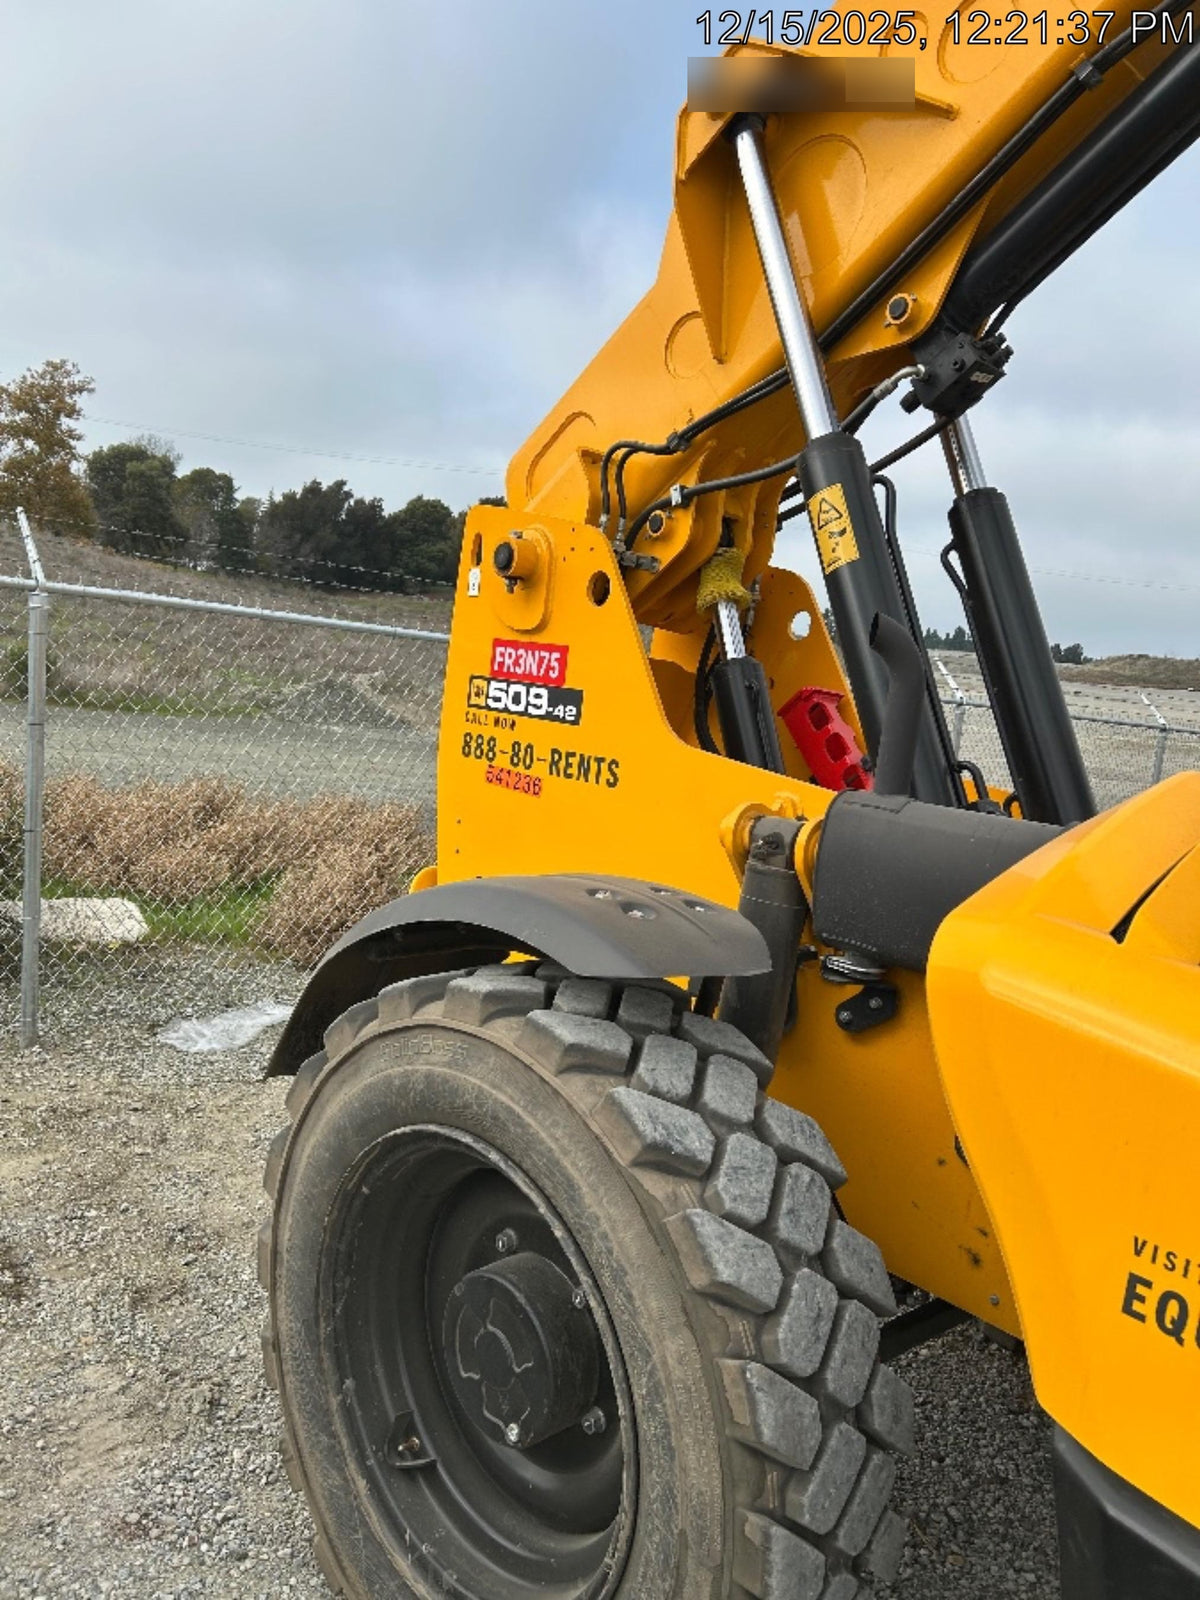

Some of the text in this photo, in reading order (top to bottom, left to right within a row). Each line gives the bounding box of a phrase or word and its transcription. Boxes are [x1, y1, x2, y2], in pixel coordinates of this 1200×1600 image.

[493, 646, 561, 678] FR3N75
[465, 710, 516, 731] CALL NOW
[462, 732, 620, 788] 888-80-RENTS
[486, 764, 542, 796] 541236
[1133, 1235, 1200, 1285] VISI
[1121, 1271, 1200, 1350] EQ
